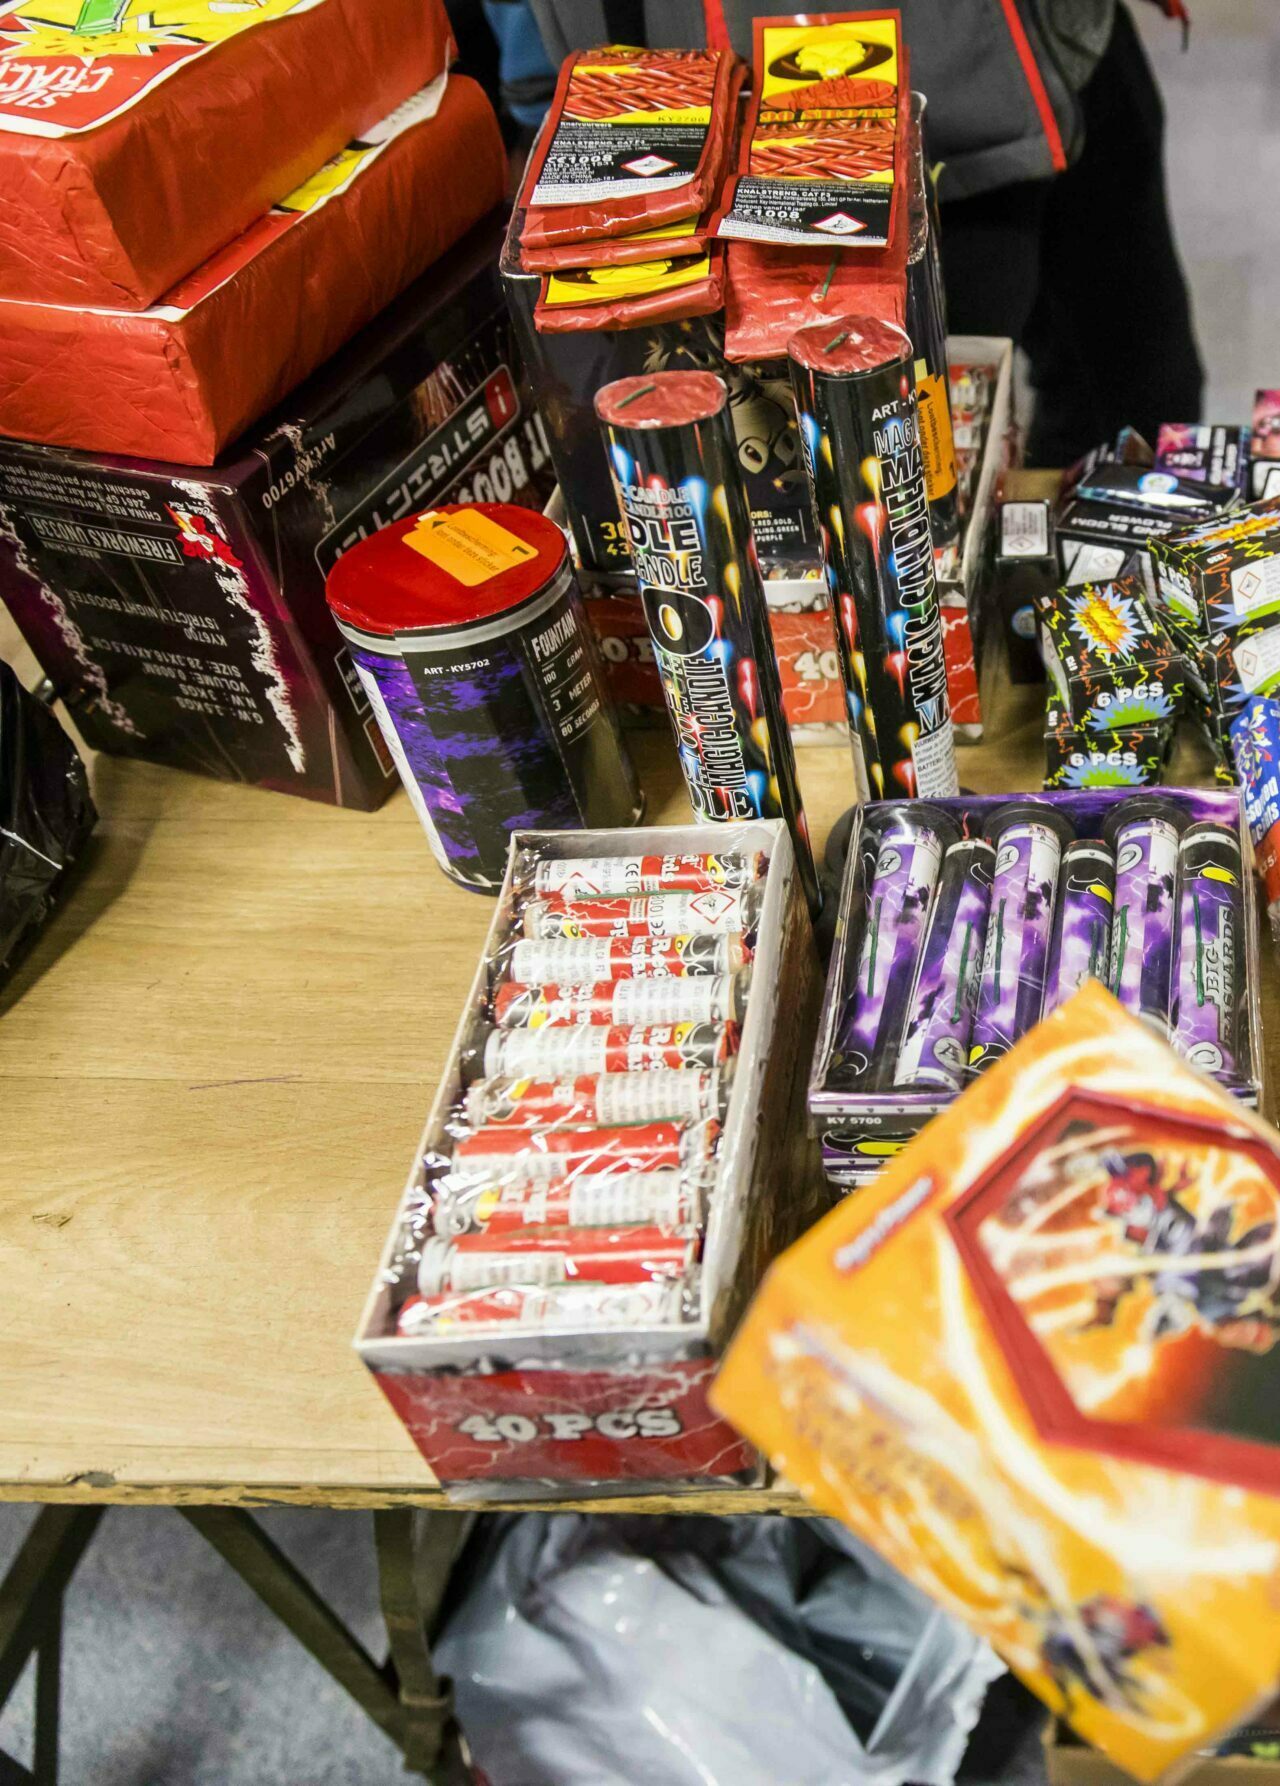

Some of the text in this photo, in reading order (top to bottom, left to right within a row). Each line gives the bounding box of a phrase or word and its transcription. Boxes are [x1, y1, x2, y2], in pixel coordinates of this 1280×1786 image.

[872, 400, 898, 421] ART
[104, 484, 150, 500] Geschikt
[108, 494, 126, 506] GP
[130, 498, 146, 510] 2461
[130, 508, 162, 522] CHINA
[33, 517, 177, 560] FIREWORKS UN0336
[1158, 560, 1193, 596] 6 PCS
[532, 608, 577, 662] FOUNTAIN
[424, 658, 490, 676] ART KY5702
[544, 671, 556, 685] 100
[553, 672, 592, 712] 3 METER
[1097, 682, 1164, 708] 6 PCS
[1070, 751, 1138, 767] 6 PCS
[1204, 944, 1220, 994] BIG
[1221, 905, 1234, 1042] BASTARDS
[826, 1116, 882, 1126] KY 5700
[459, 1408, 683, 1442] 40 PCS
